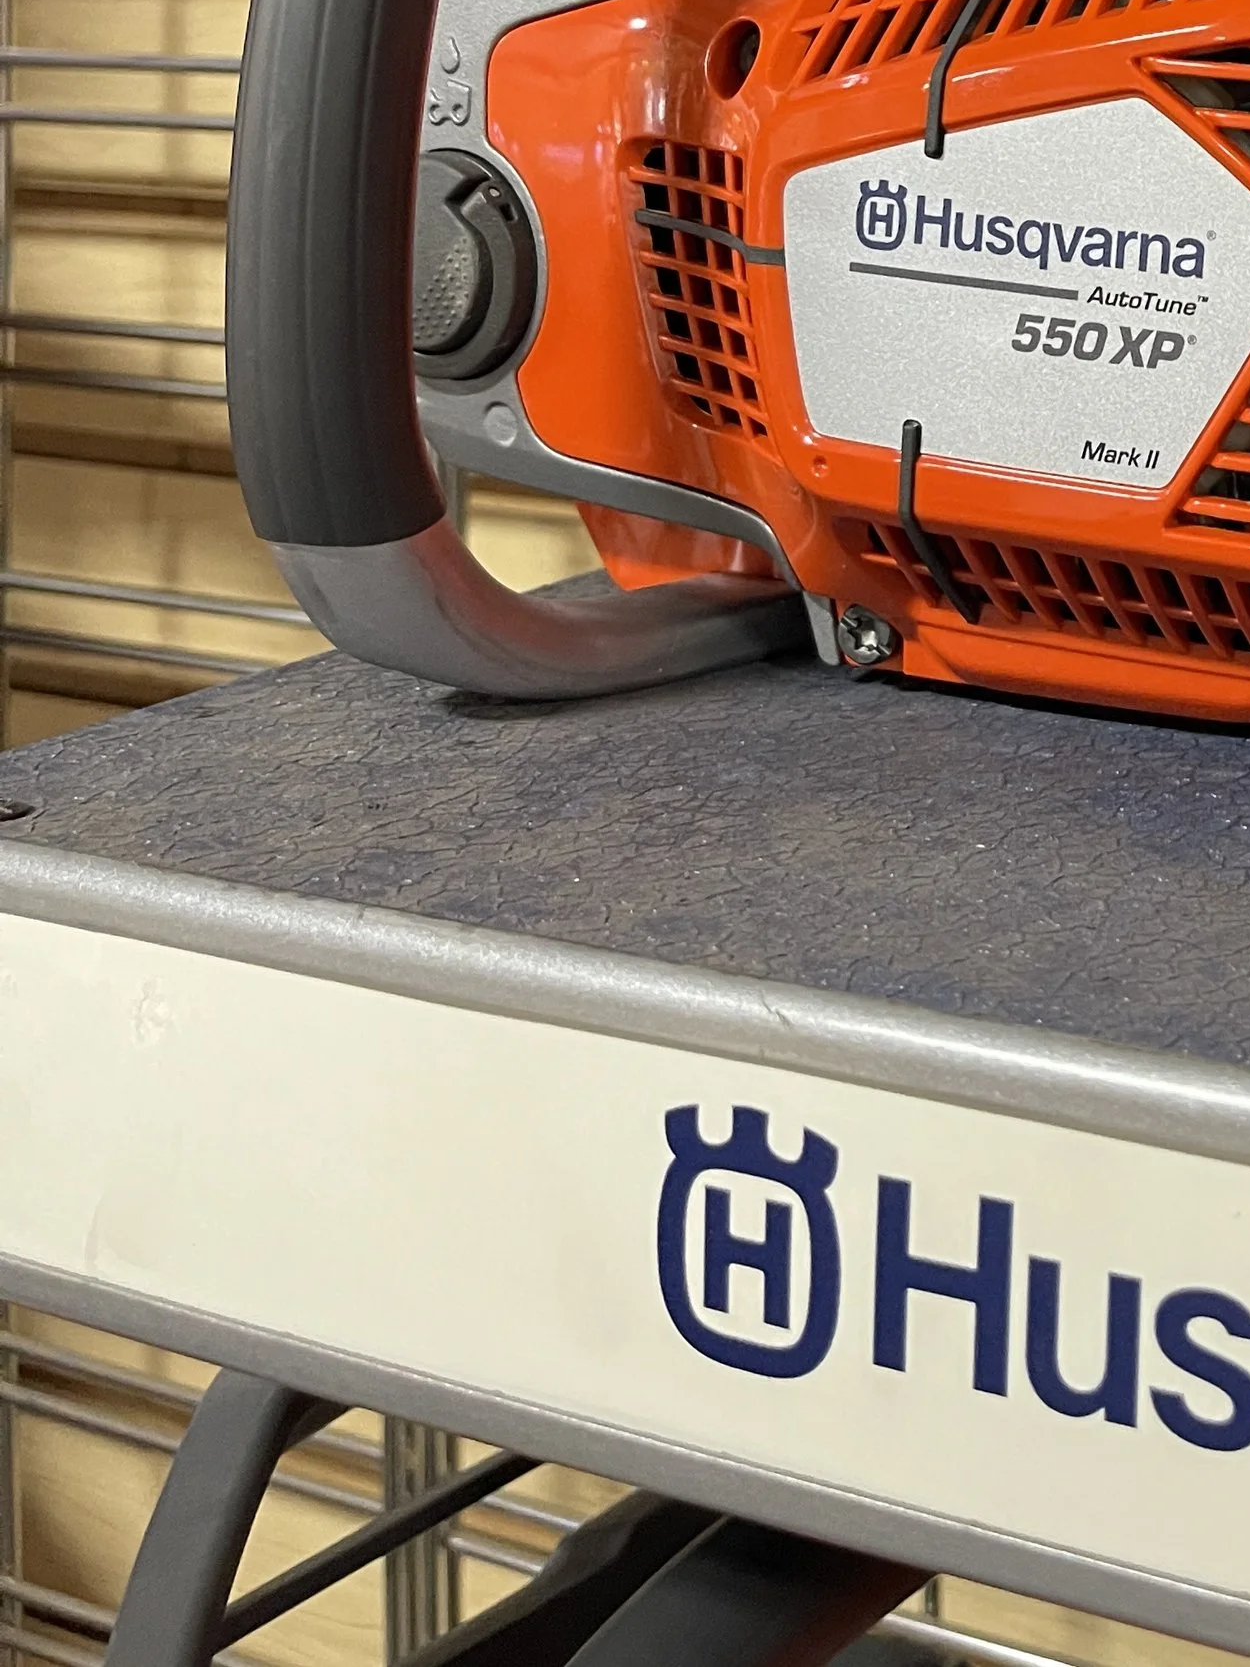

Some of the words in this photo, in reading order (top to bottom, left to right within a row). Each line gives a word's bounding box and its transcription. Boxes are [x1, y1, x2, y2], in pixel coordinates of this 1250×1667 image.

[1011, 313, 1109, 361] 550
[1080, 439, 1142, 468] Mark
[1144, 449, 1160, 470] II
